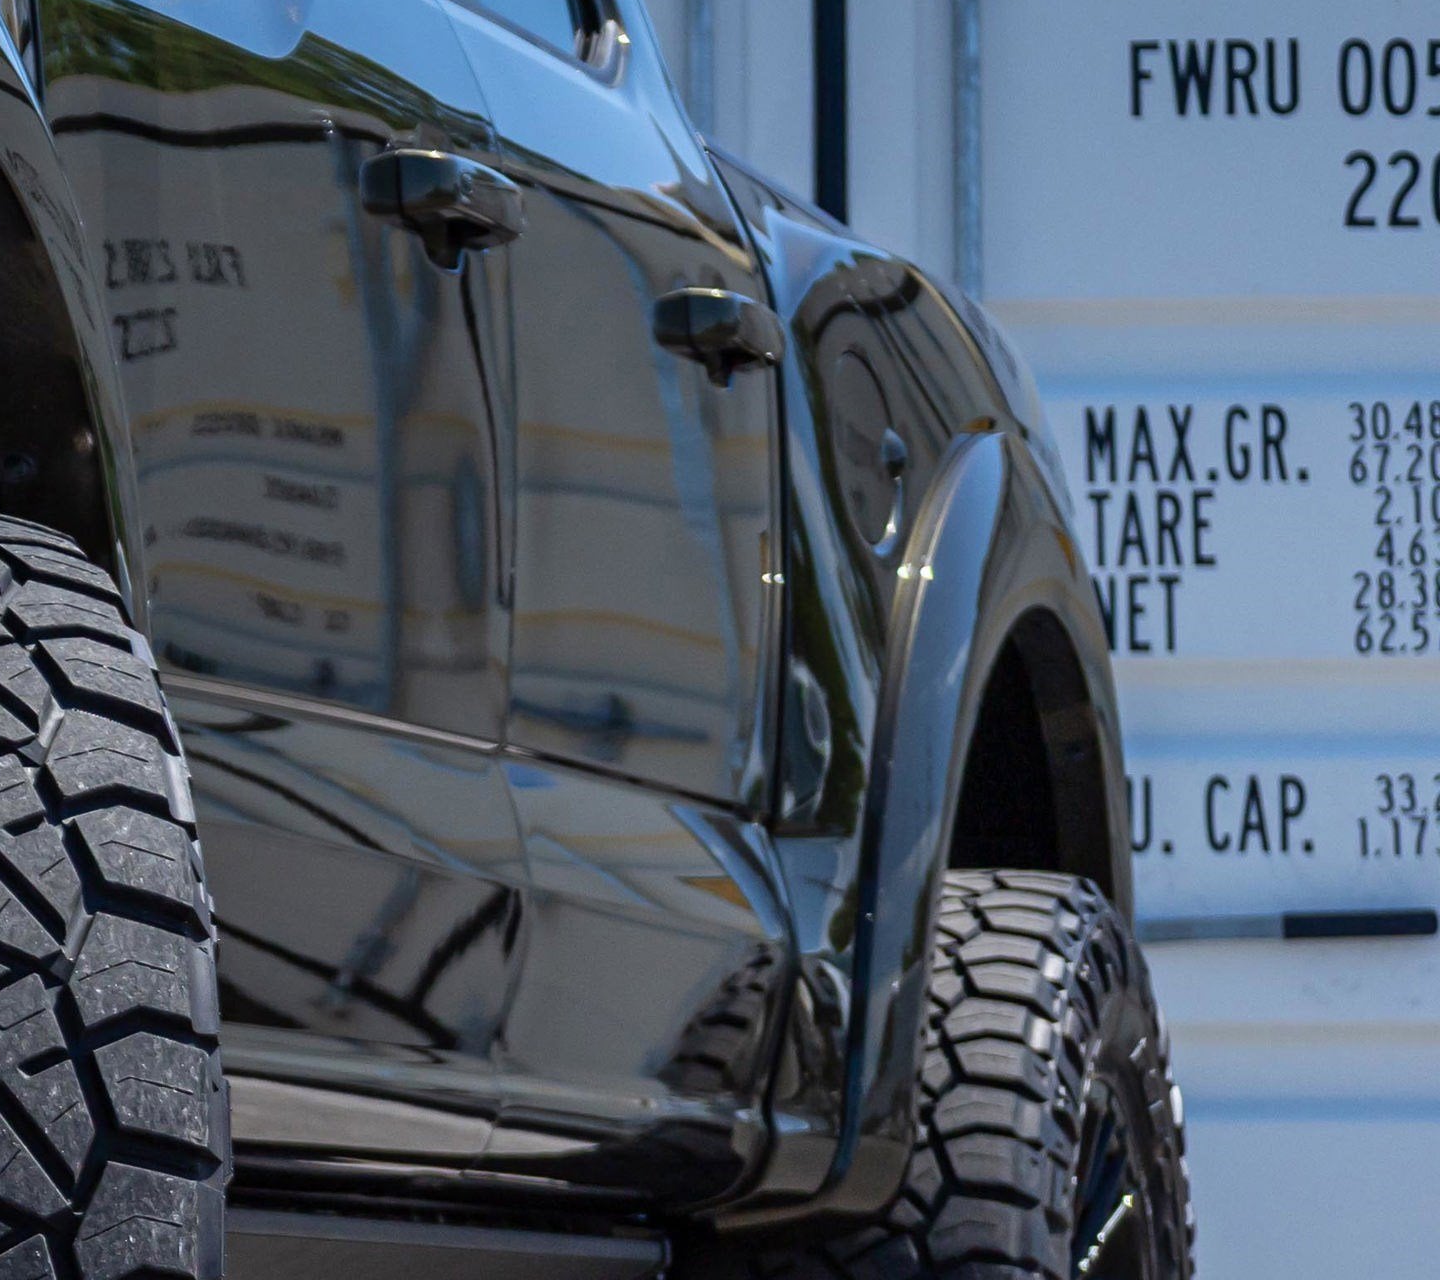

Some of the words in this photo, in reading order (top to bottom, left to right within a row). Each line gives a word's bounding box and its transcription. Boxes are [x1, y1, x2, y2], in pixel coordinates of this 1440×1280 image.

[1129, 36, 1301, 118] FWRU
[1344, 149, 1440, 228] 22
[1088, 488, 1217, 568] TARE
[1091, 574, 1182, 653] NET
[1355, 610, 1440, 653] 62.5
[1204, 773, 1316, 855] CAP.
[1358, 816, 1440, 857] 1.17
